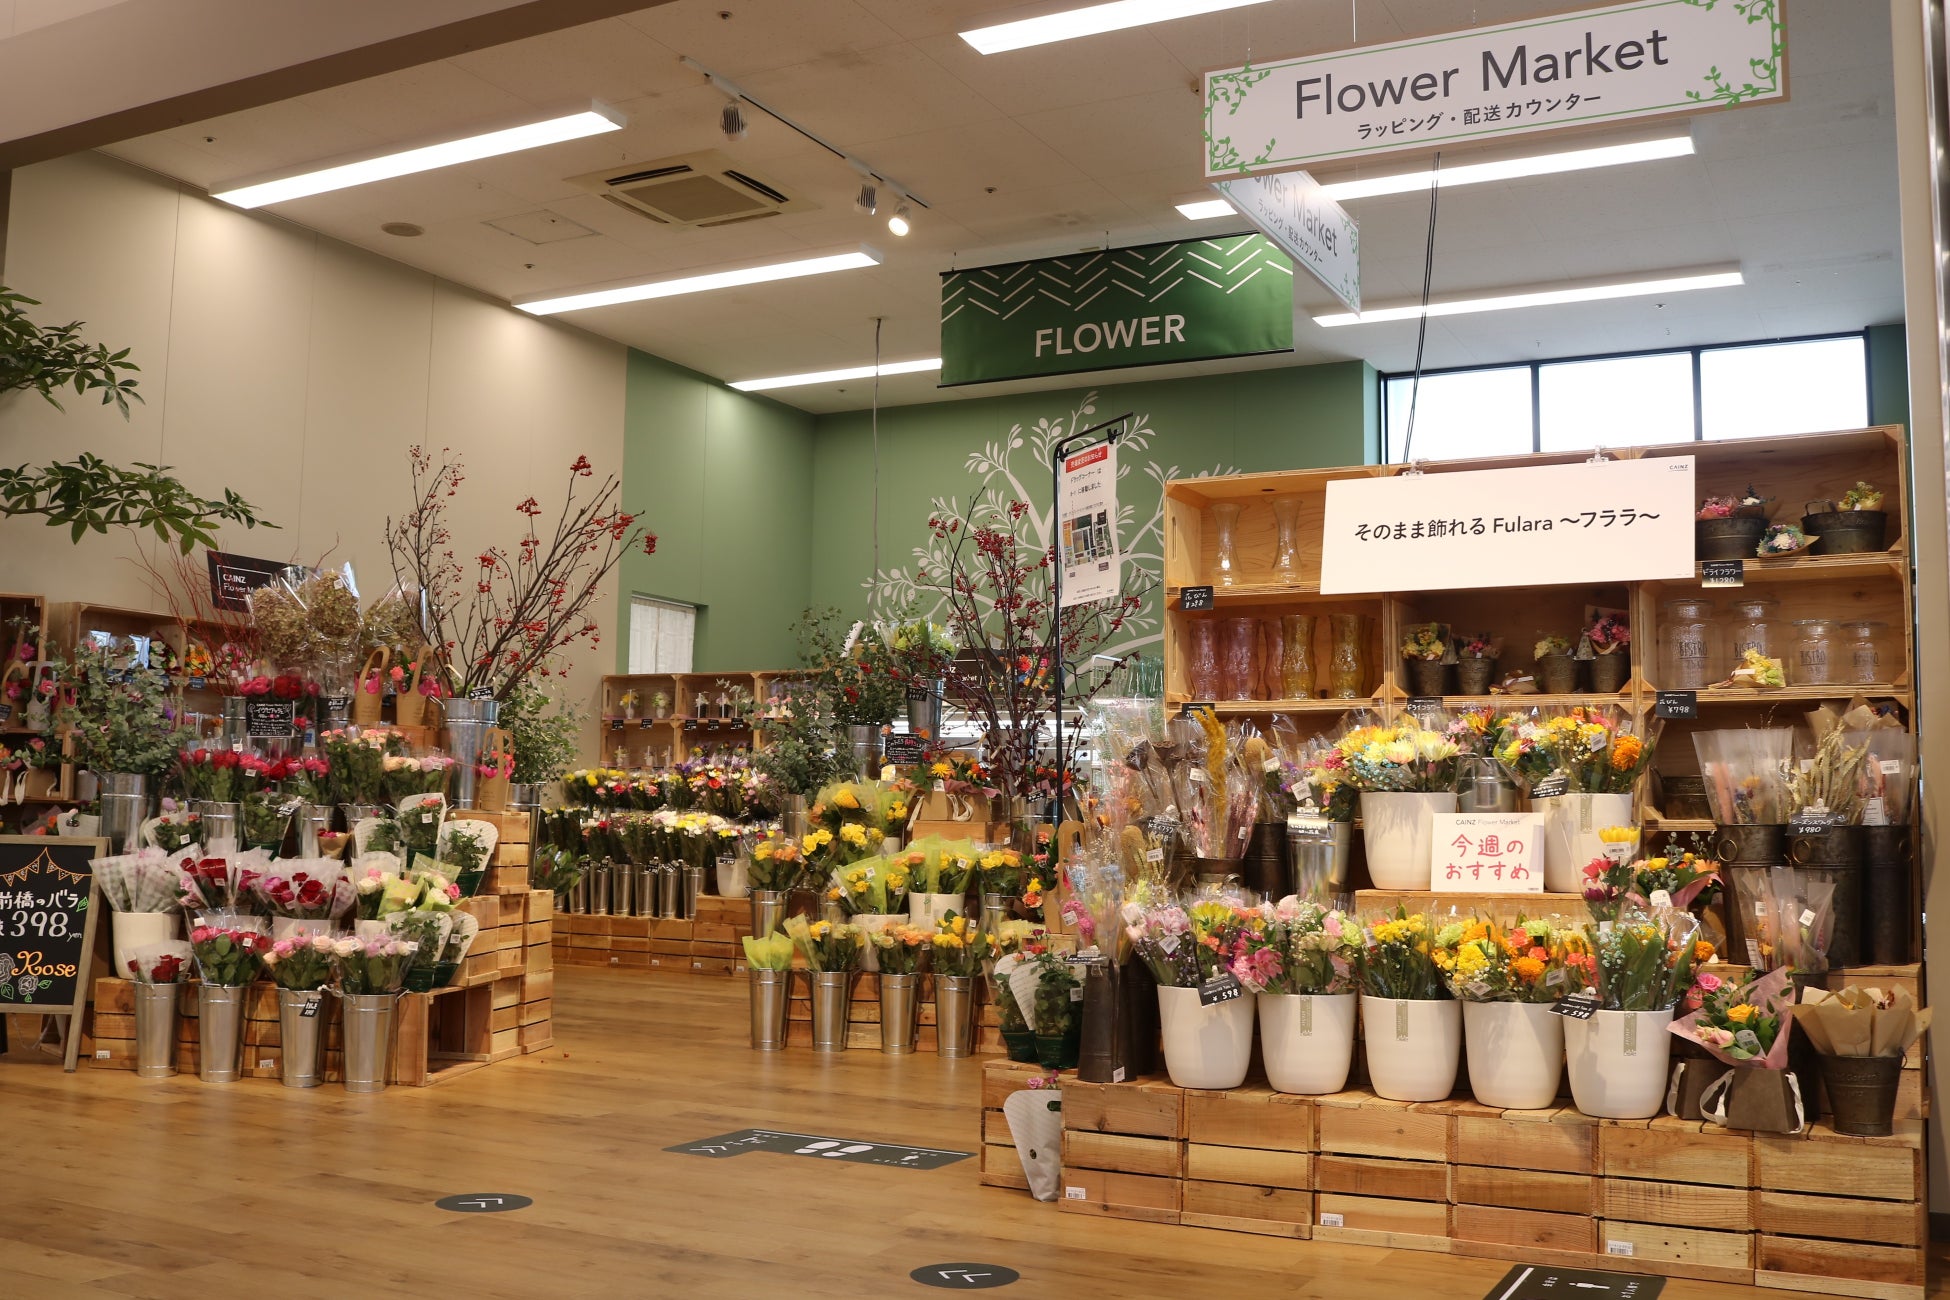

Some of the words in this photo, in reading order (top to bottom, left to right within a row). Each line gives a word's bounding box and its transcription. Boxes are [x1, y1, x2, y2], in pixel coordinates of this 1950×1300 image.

[1296, 67, 1460, 119] Flower
[1481, 29, 1669, 92] Market
[1293, 184, 1338, 257] Market
[1035, 314, 1186, 357] FLOWER
[1354, 516, 1486, 541] そのまま飾れる
[1493, 515, 1553, 533] Fulara
[223, 574, 246, 584] CAINZ
[1451, 834, 1524, 857] 今週の
[1446, 861, 1530, 880] おすすめ
[0, 889, 79, 910] 前橋のバラ
[11, 910, 69, 937] 398
[66, 931, 83, 943] yen
[11, 951, 77, 978] Rose
[1222, 988, 1239, 999] 598
[1571, 1010, 1590, 1018] 598
